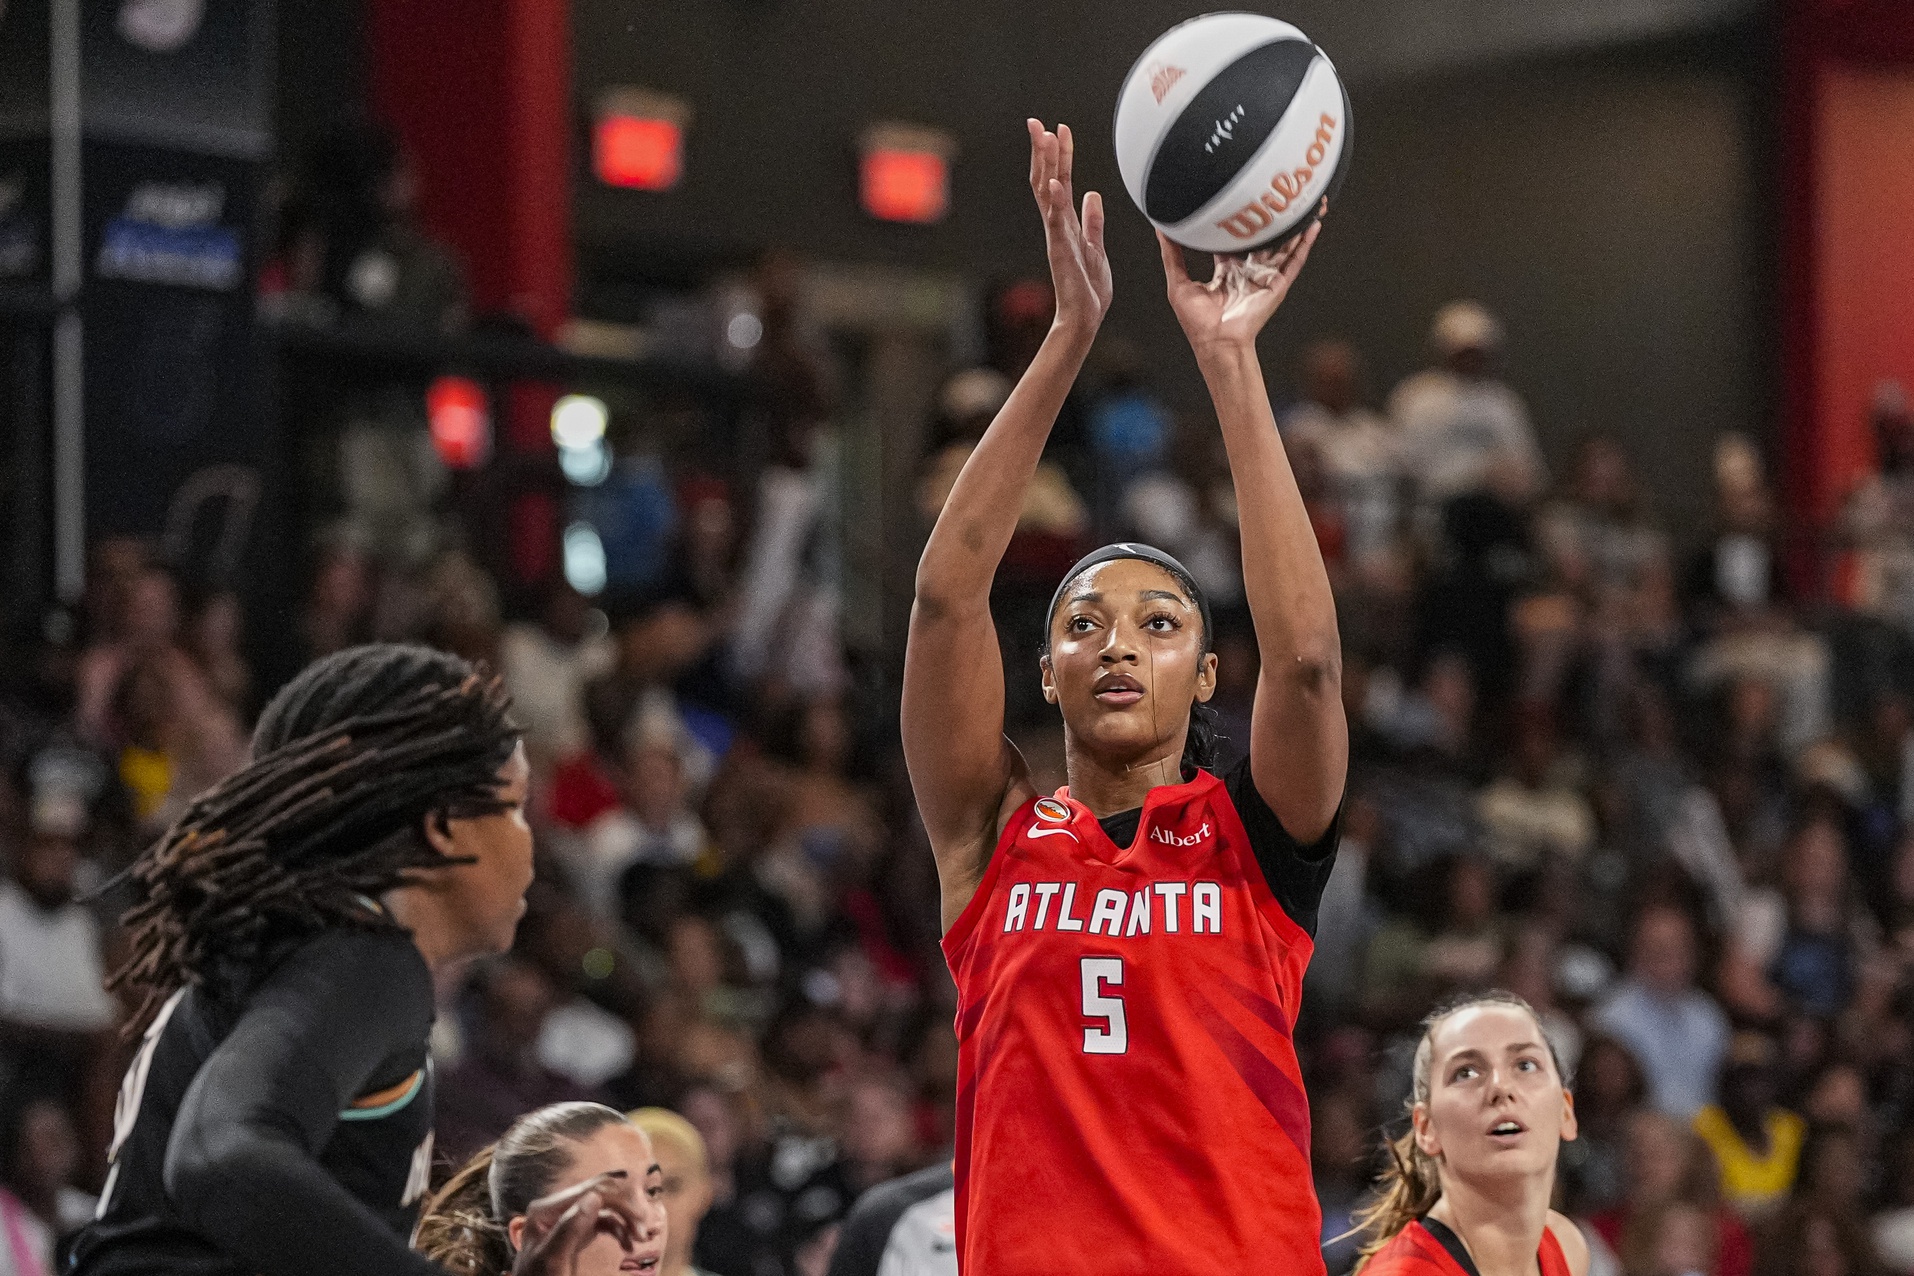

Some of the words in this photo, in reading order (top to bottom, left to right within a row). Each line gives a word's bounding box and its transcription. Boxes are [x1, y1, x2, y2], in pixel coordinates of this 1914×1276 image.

[1216, 112, 1337, 240] Wilson
[1150, 822, 1211, 847] Albert
[1003, 881, 1222, 938] ATLANTA
[1080, 955, 1128, 1055] 5
